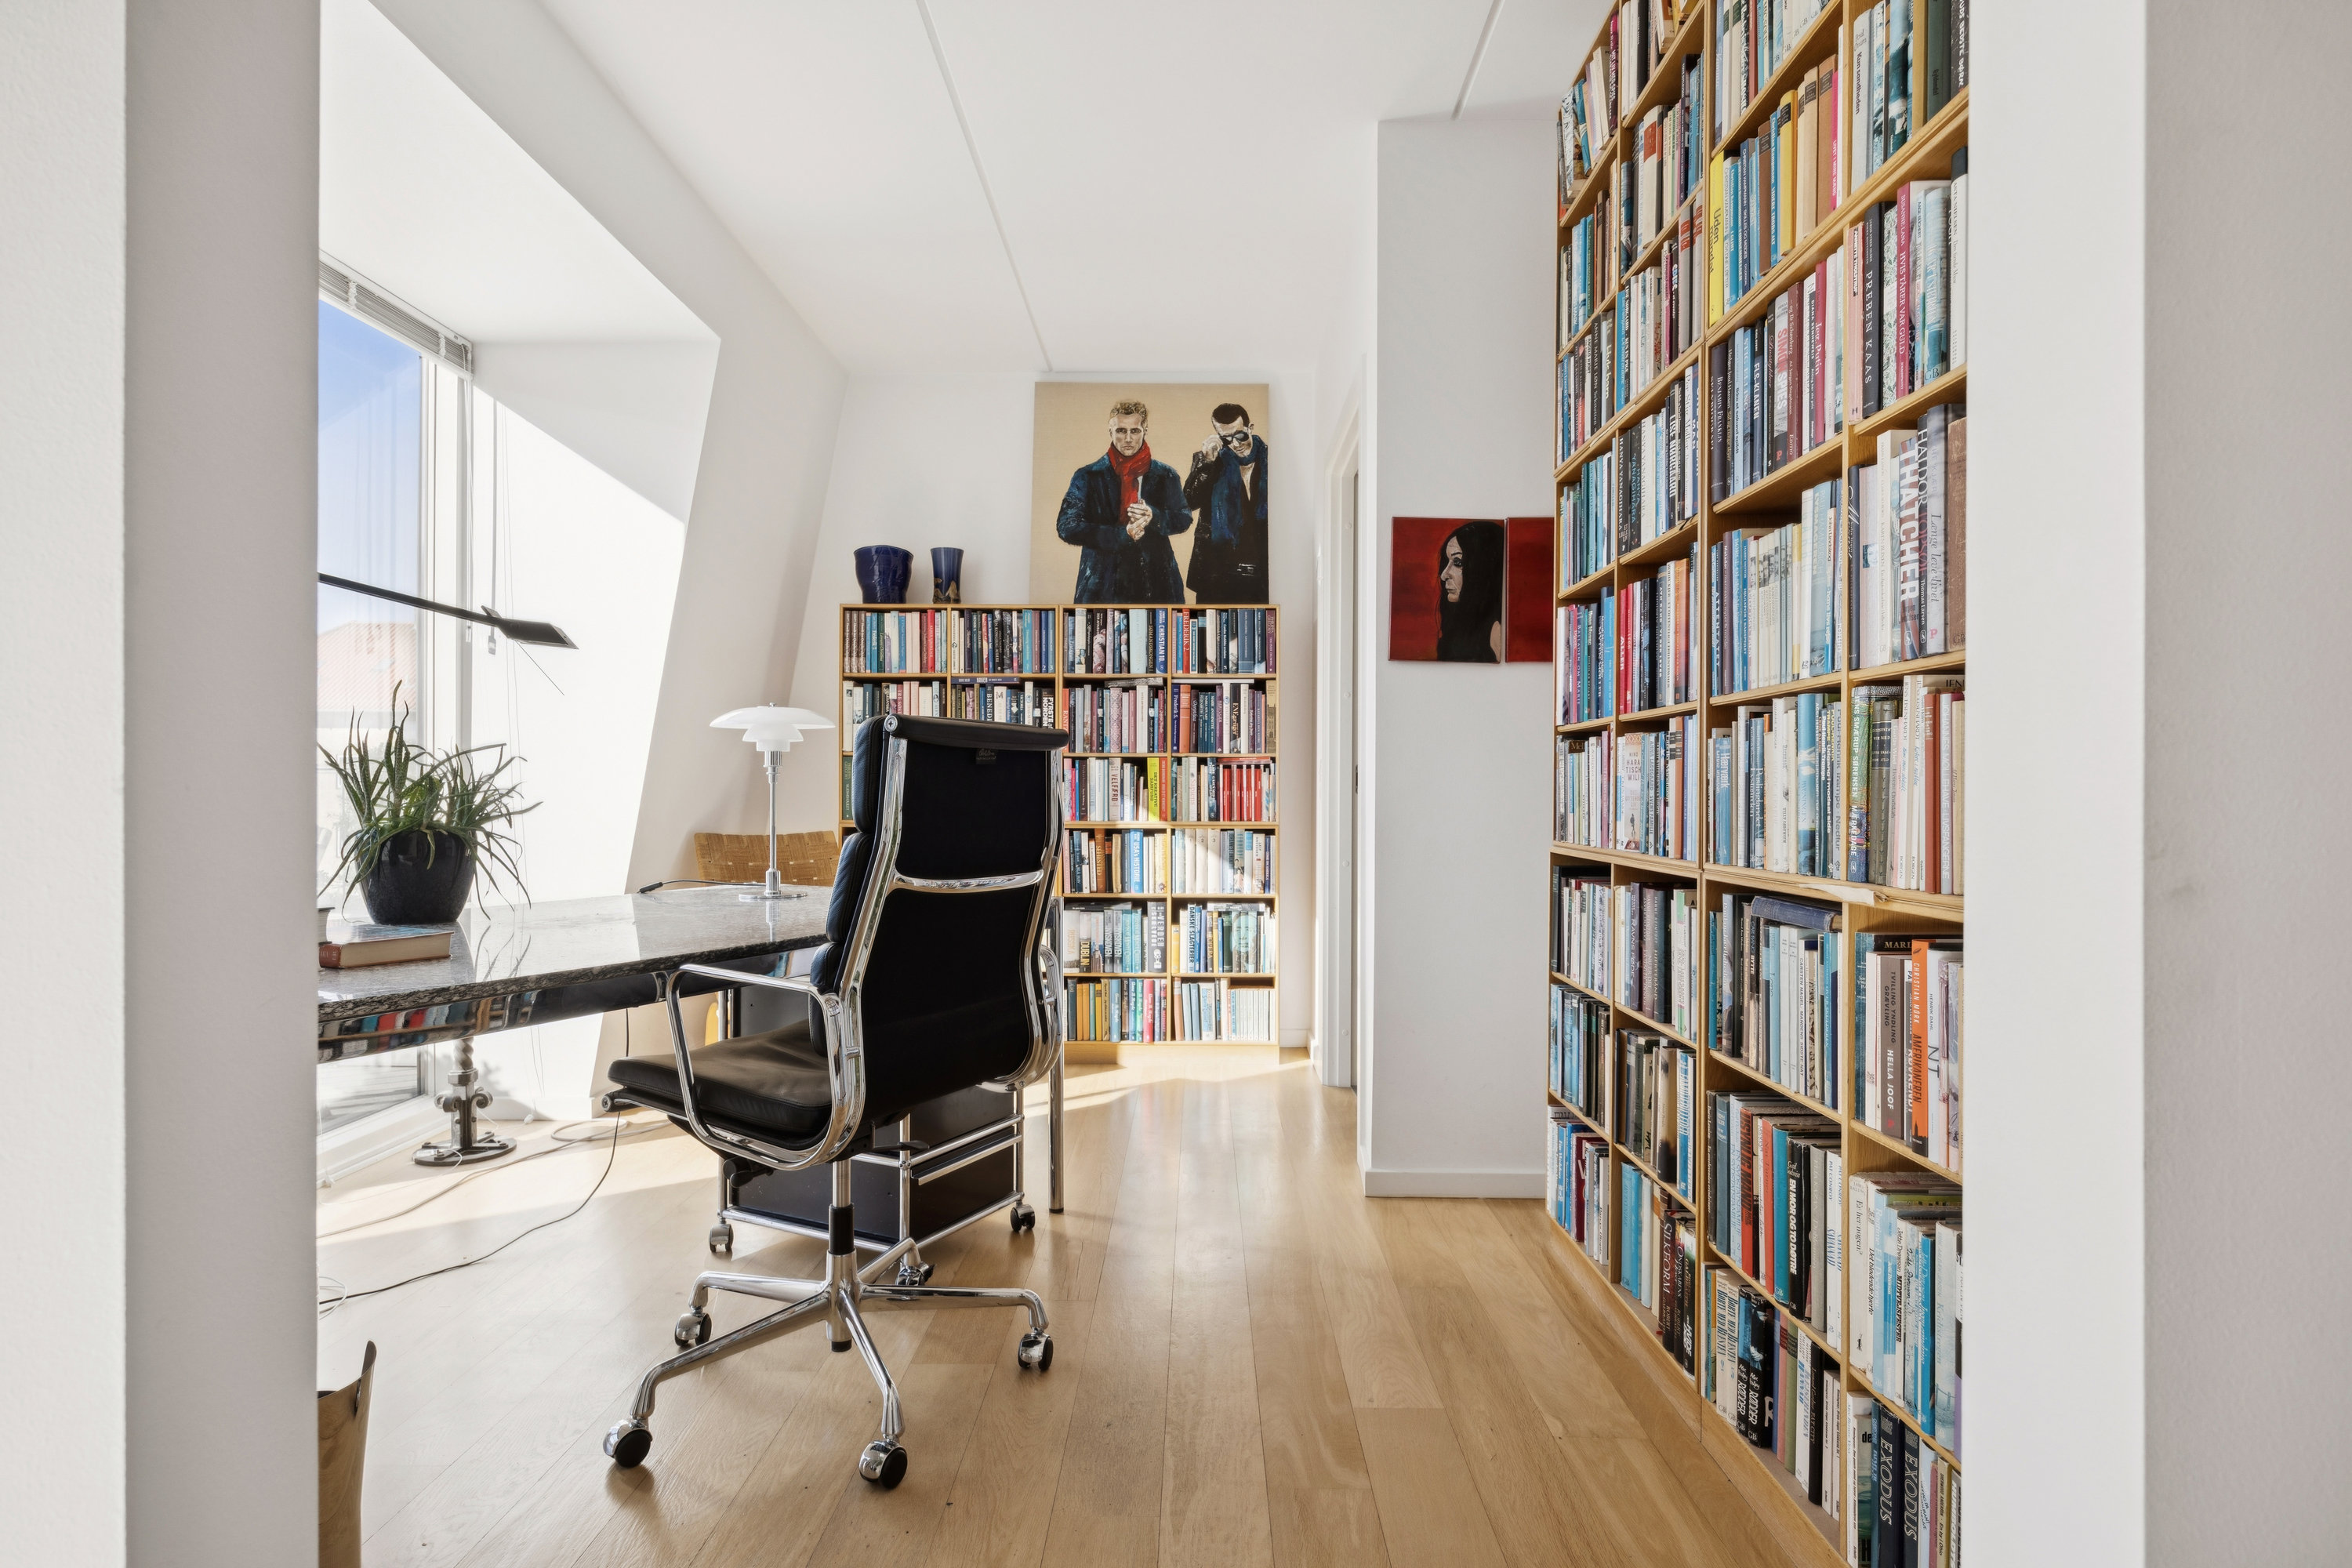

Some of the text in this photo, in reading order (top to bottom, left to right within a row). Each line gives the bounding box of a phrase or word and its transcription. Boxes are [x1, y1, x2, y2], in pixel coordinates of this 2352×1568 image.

[1777, 330, 1787, 410] SIMON SPIES
[1901, 441, 1919, 601] THATCHER
[1928, 514, 1941, 602] Længe leve livet
[1720, 753, 1730, 788] Hærværk
[1080, 941, 1090, 965] DUBLIN
[1913, 1034, 1922, 1103] AMERIKANEREN
[1790, 1178, 1797, 1191] EN
[1857, 1200, 1863, 1210] Er
[1790, 1217, 1796, 1230] OG
[1790, 1231, 1796, 1243] TO
[1738, 1380, 1746, 1415] RØDDER
[1749, 1390, 1758, 1425] RØDDER
[1880, 1437, 1892, 1525] EXODUS
[1904, 1451, 1917, 1540] EXODUS
